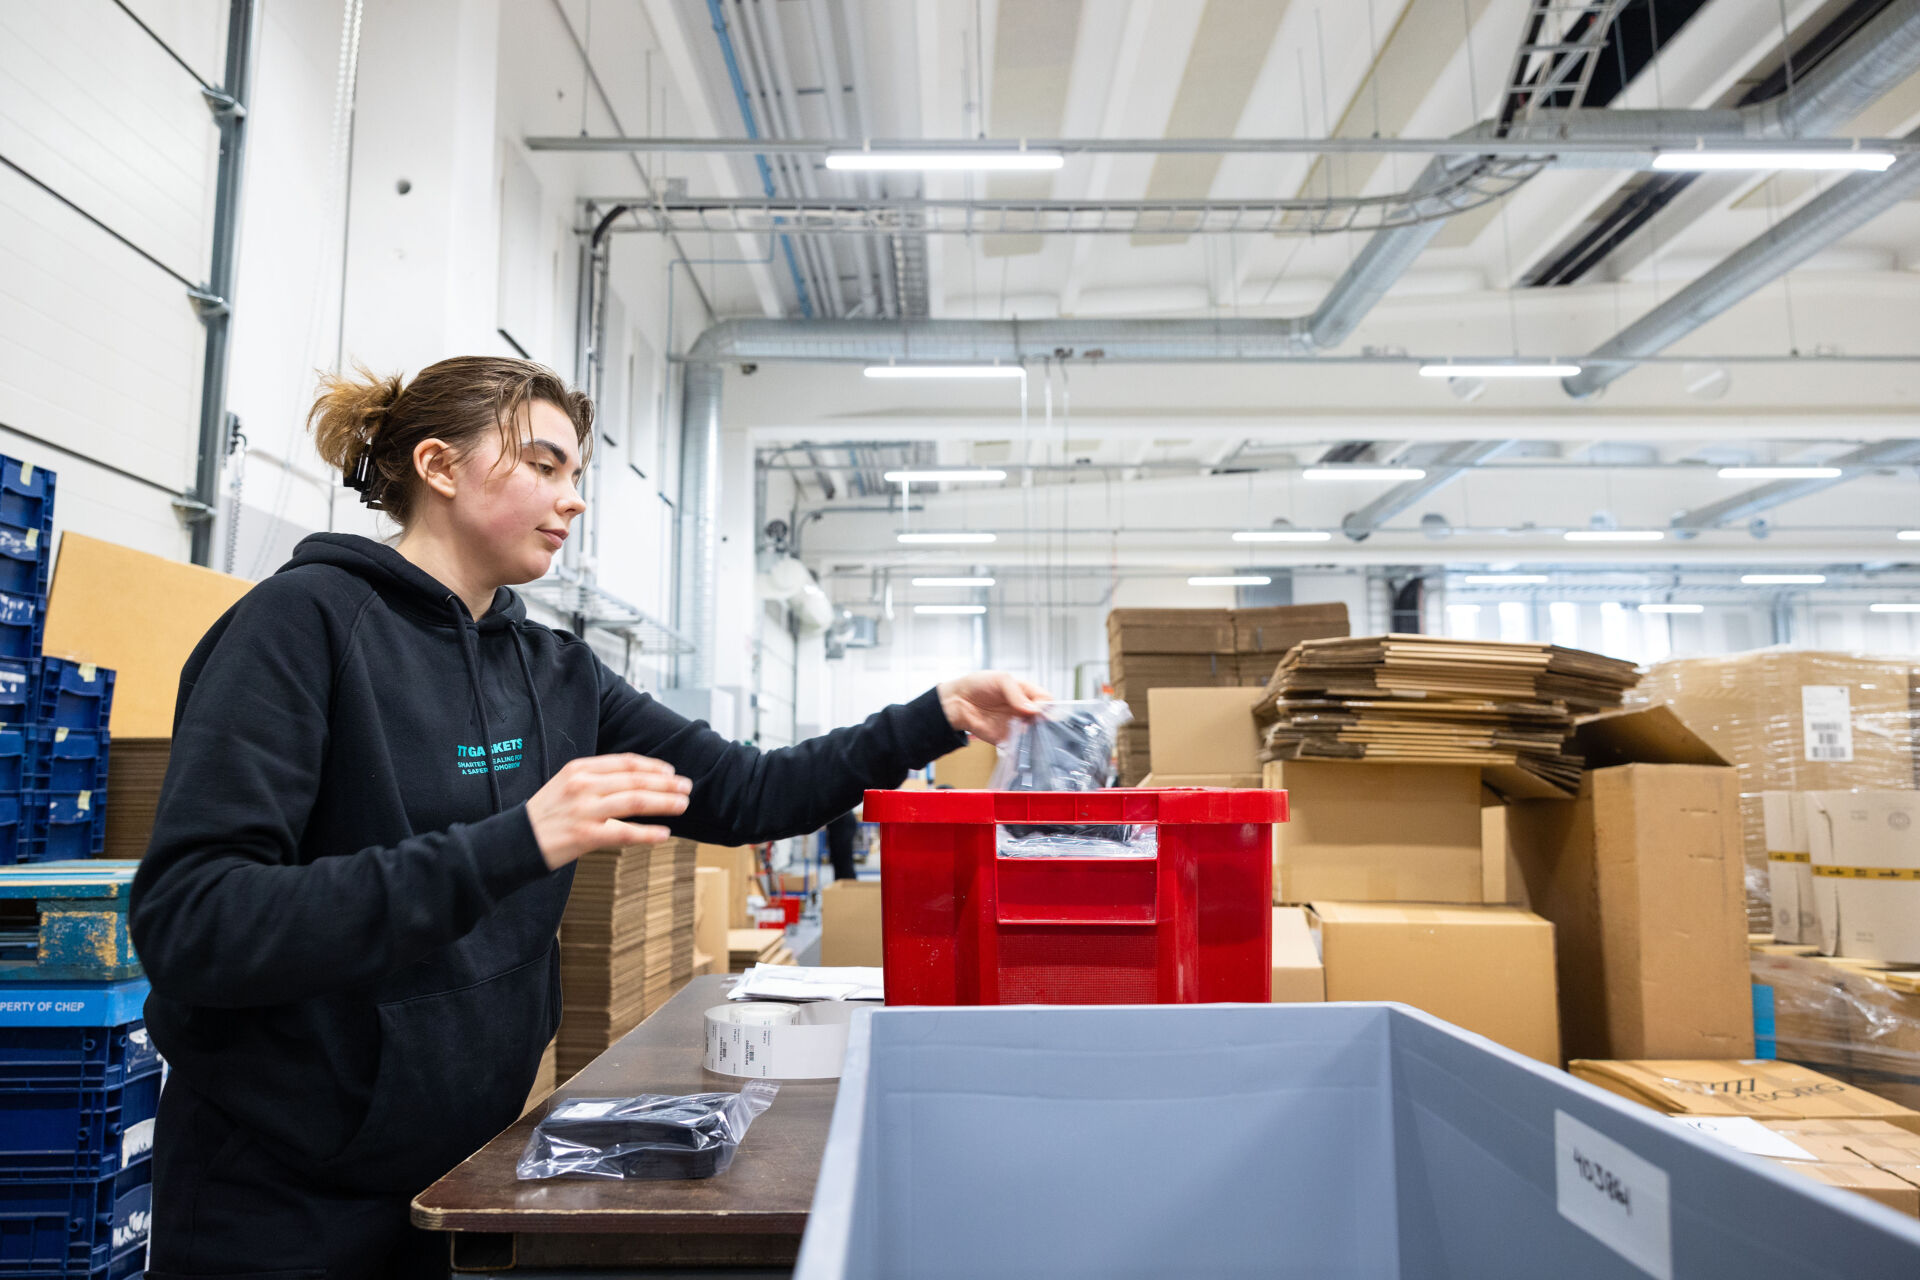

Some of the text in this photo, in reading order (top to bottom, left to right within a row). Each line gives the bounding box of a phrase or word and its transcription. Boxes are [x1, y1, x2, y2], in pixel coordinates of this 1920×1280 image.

[467, 738, 523, 757] GAKETS
[492, 755, 515, 765] EALING
[467, 767, 488, 775] SAFER
[493, 761, 521, 771] OMORROW
[37, 1001, 52, 1012] OF
[54, 1001, 85, 1012] CHEP
